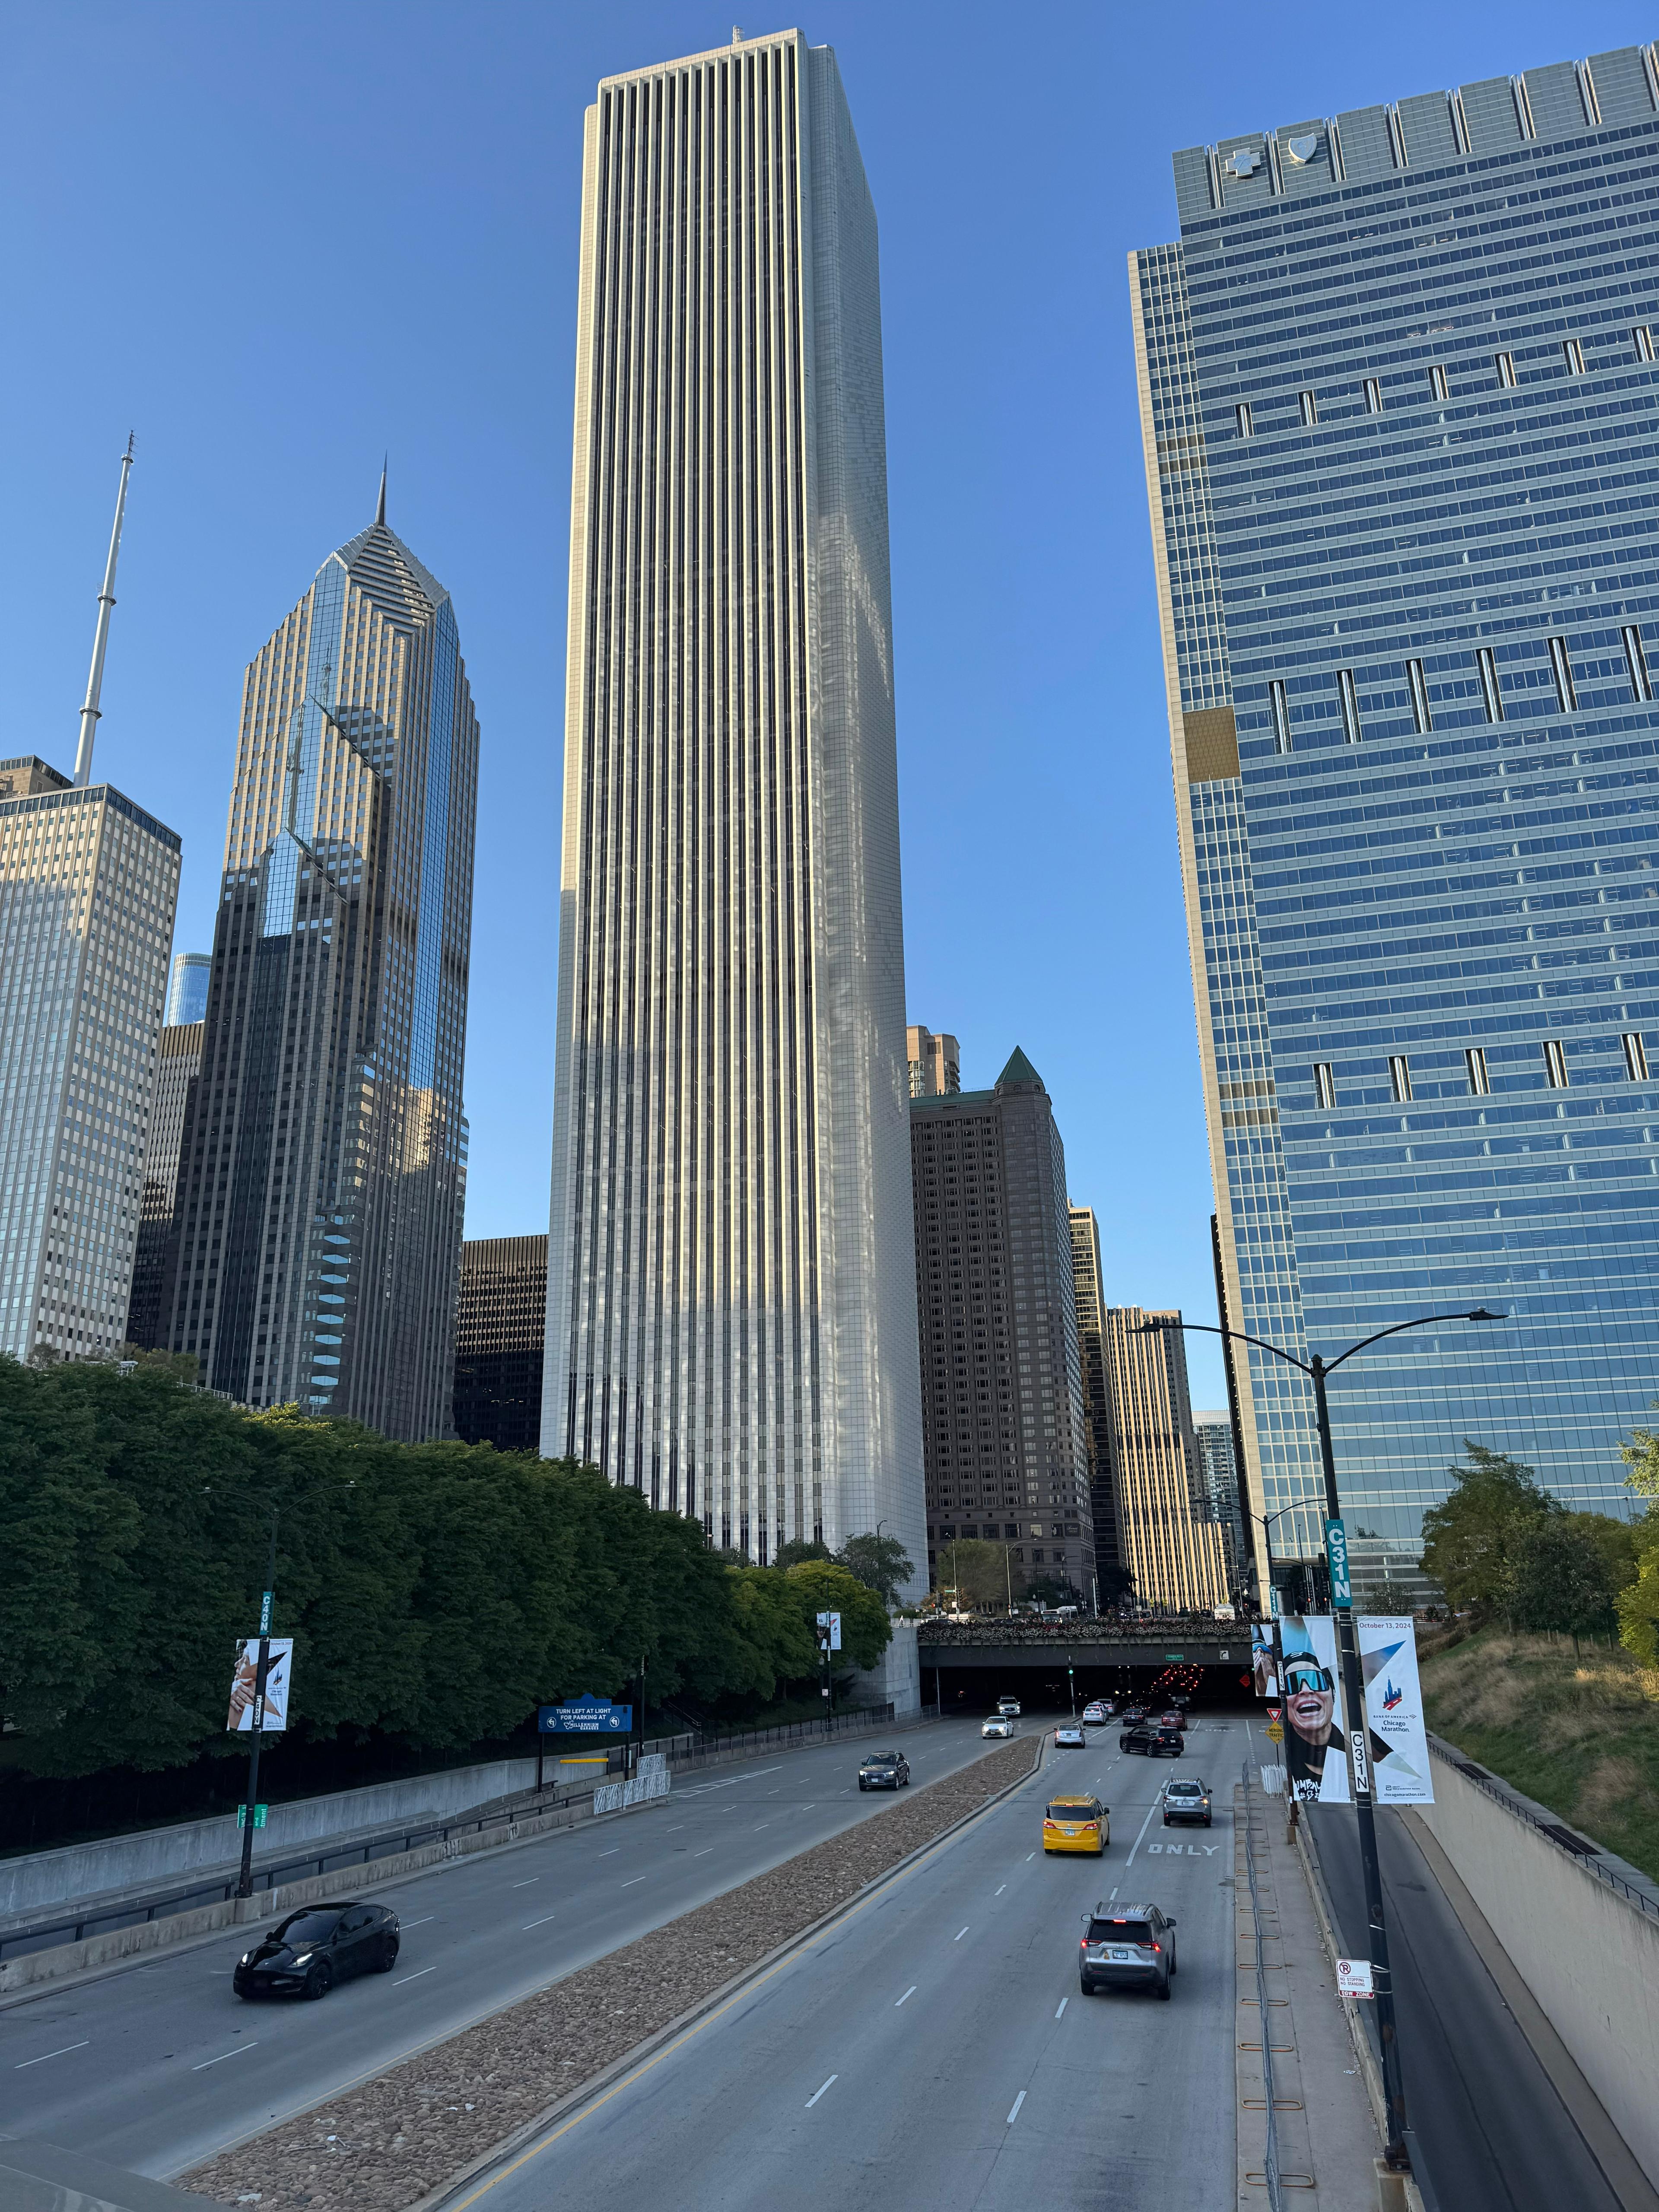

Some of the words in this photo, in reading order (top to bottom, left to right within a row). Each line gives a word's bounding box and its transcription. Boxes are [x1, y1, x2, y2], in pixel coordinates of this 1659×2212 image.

[1328, 1528, 1351, 1598] C31N
[260, 1596, 270, 1630] C40N
[1270, 1586, 1278, 1618] C111N
[1353, 1734, 1367, 1789] C31N
[1147, 1844, 1220, 1856] ONLY
